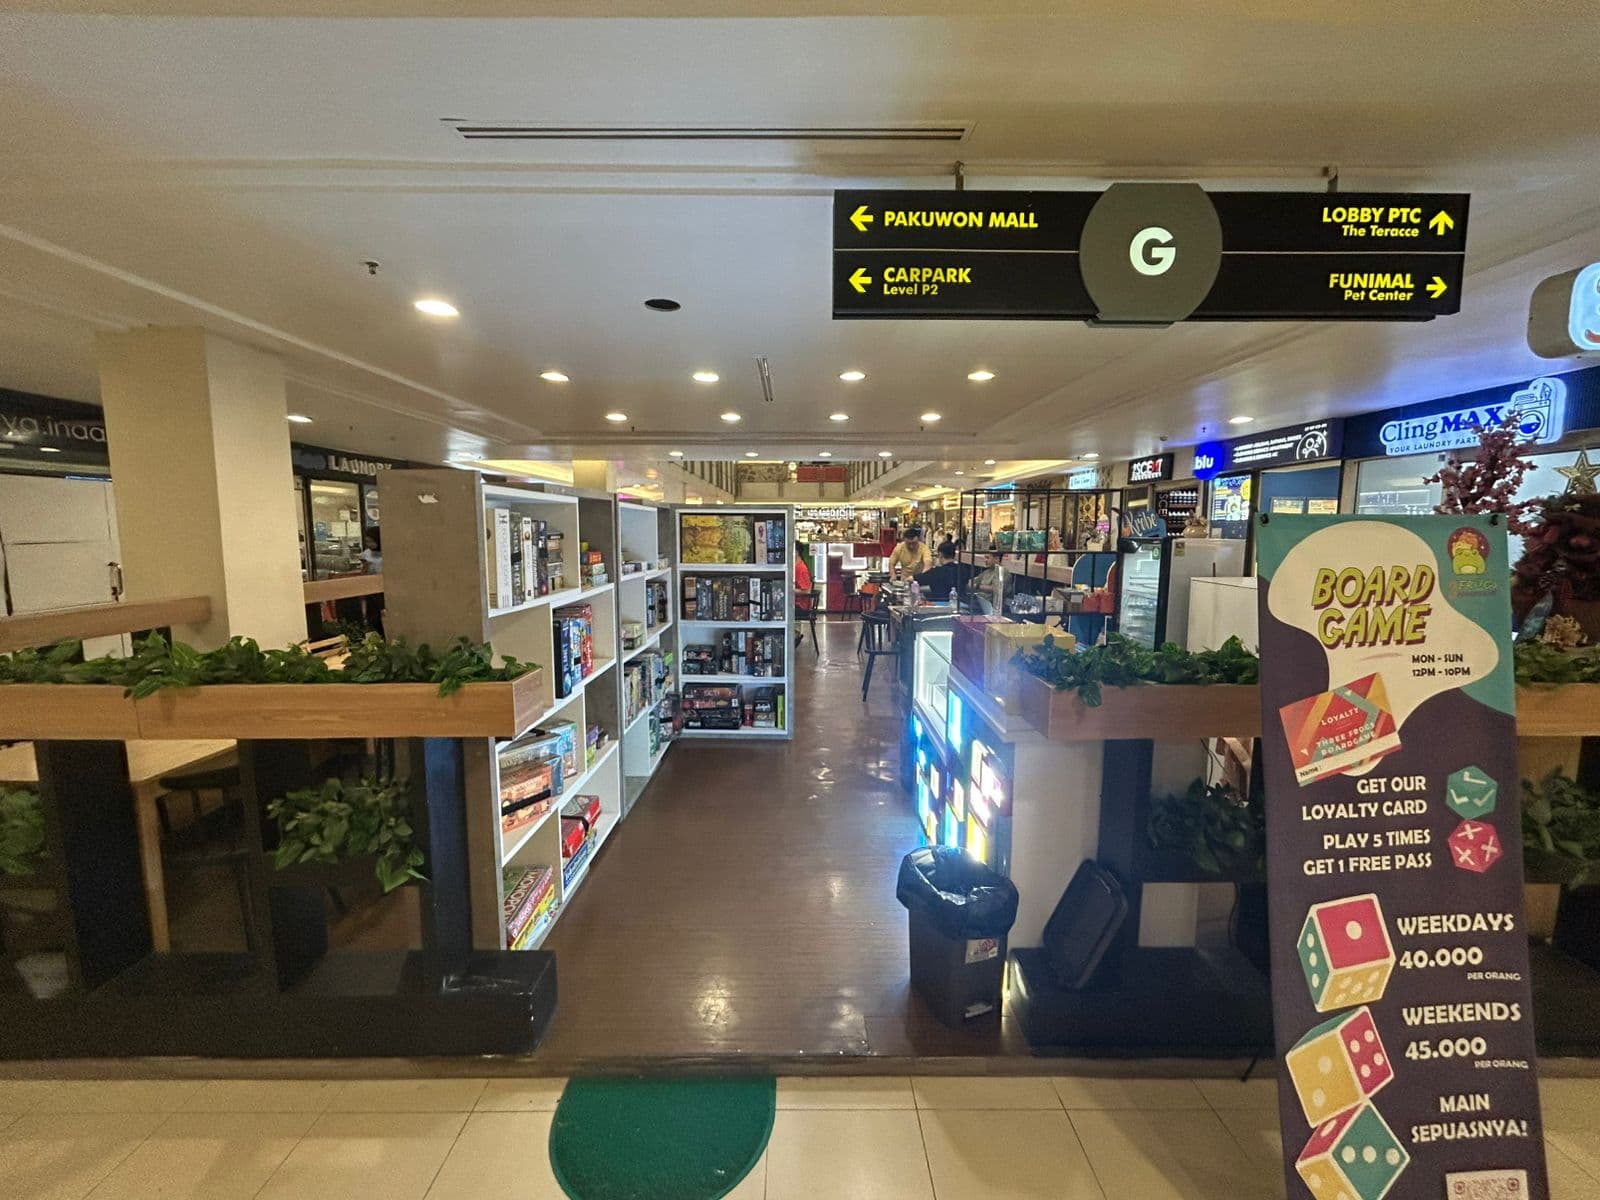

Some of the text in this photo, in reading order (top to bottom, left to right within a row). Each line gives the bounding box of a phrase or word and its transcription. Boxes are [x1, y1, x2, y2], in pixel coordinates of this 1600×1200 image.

[884, 210, 1039, 229] PAKUWON MALL
[1322, 206, 1423, 224] LOBBY PTC
[1341, 223, 1421, 238] The Teracce
[1129, 226, 1176, 276] G
[883, 266, 972, 284] CARPARK
[1328, 273, 1415, 289] FUNIMAL
[883, 282, 940, 296] Level P2
[1343, 287, 1414, 301] Pet Center
[1390, 445, 1411, 453] YOUR
[1414, 440, 1451, 451] LAUNDRY
[1194, 455, 1214, 469] blu
[1311, 564, 1435, 610] BOARD
[1318, 603, 1432, 650] GAME
[1411, 654, 1436, 664] MON
[1444, 653, 1464, 663] SUN
[1412, 667, 1436, 677] 12PM
[1444, 666, 1471, 676] 10PM
[1322, 707, 1360, 726] LOYALTY
[1316, 733, 1347, 747] THREE
[1300, 767, 1319, 777] Name
[1356, 775, 1427, 794] GET OUR
[1302, 799, 1428, 821] LOYALTY CARD
[1323, 828, 1432, 850] PLAY 5 TIMES
[1303, 852, 1433, 876] GET 1 FREE PASS
[1396, 912, 1515, 936] WEEKDAYS
[1399, 946, 1484, 970] 40.000
[1466, 971, 1522, 981] PER ORANG
[1402, 1001, 1522, 1027] WEEKENDS
[1405, 1036, 1488, 1060] 45.000
[1474, 1059, 1529, 1070] PER ORANG
[1439, 1093, 1491, 1114] MAIN
[1411, 1118, 1529, 1144] SEPUASNYA!
